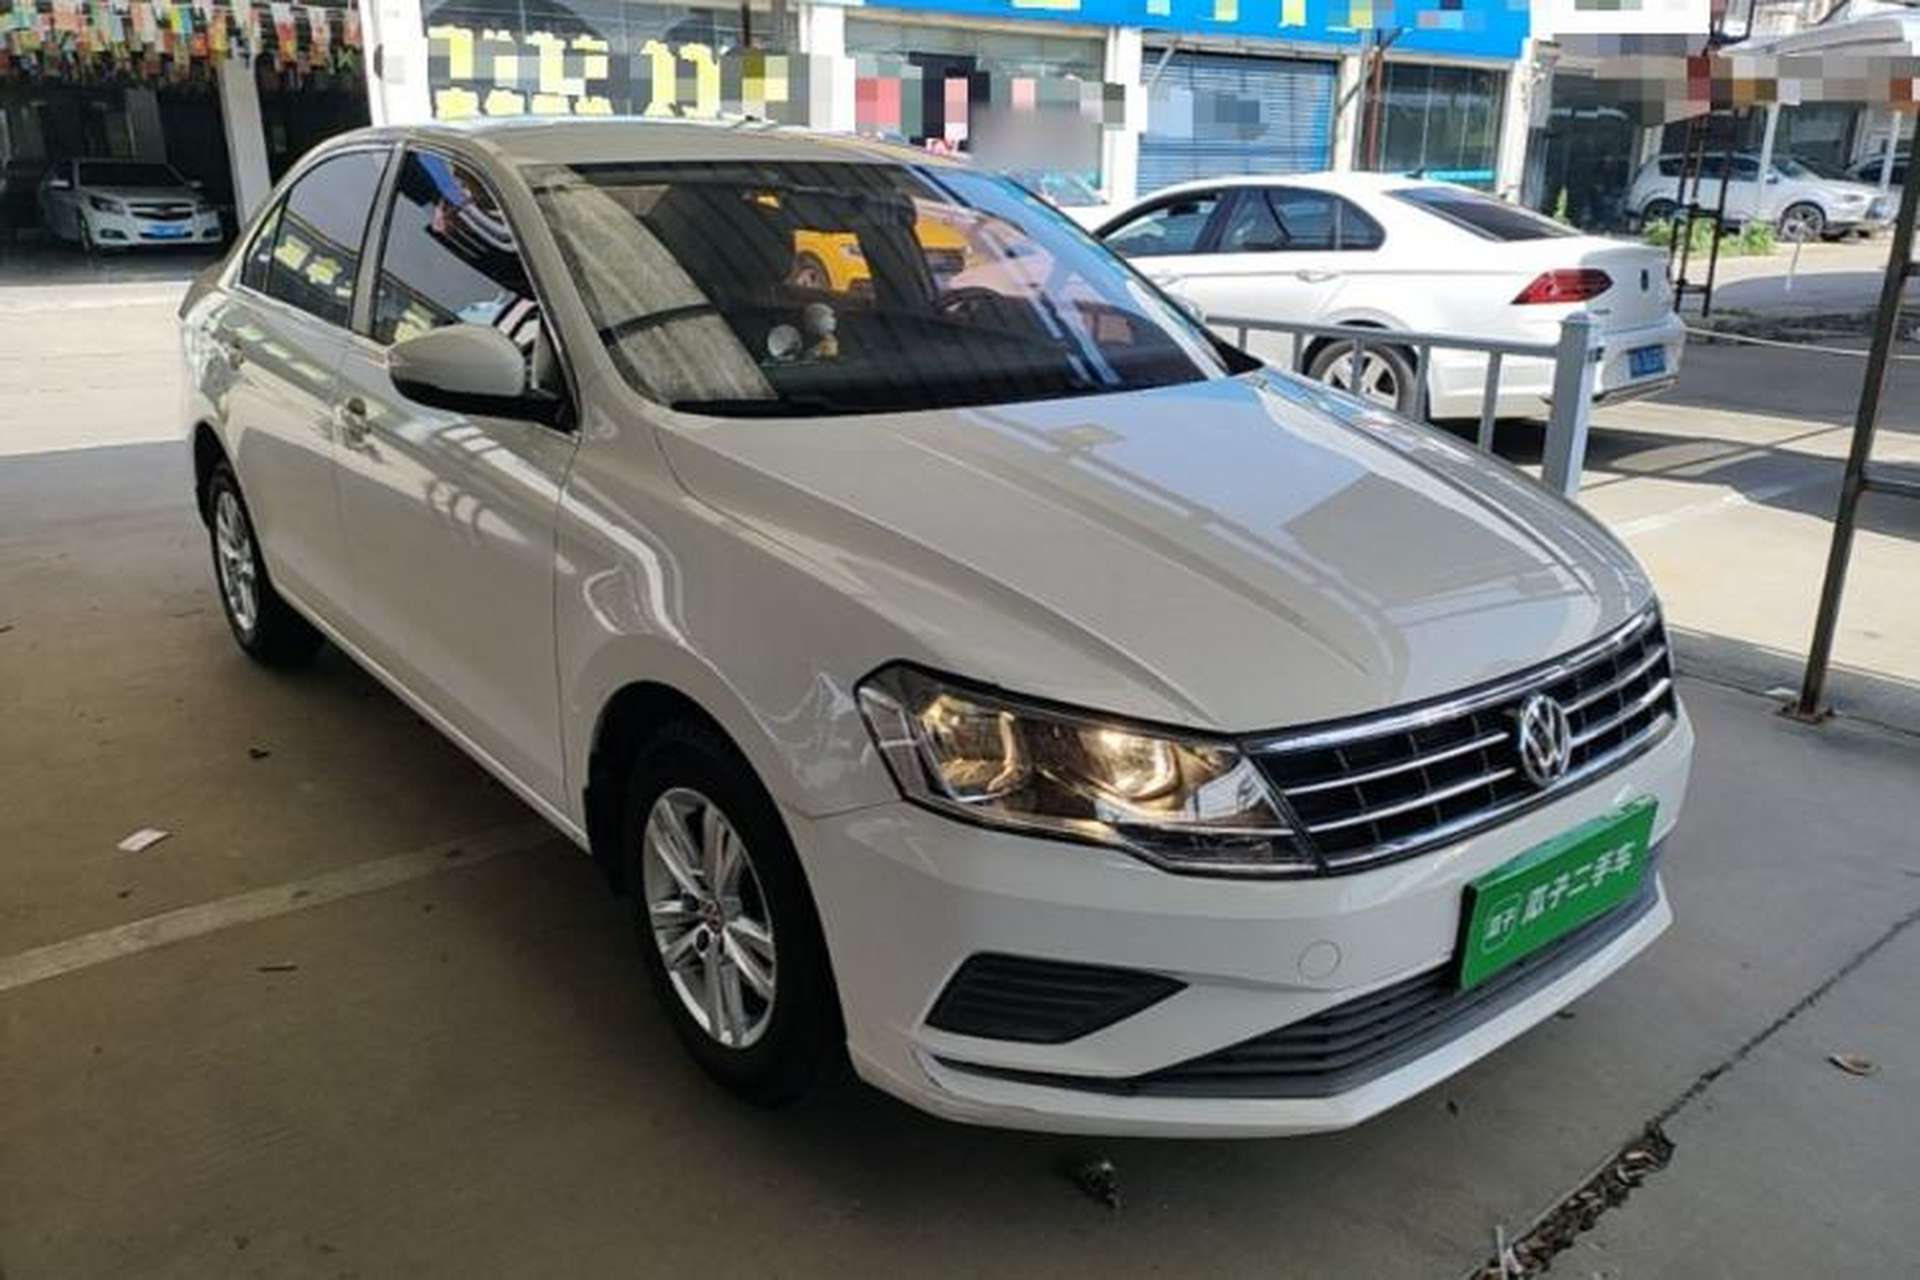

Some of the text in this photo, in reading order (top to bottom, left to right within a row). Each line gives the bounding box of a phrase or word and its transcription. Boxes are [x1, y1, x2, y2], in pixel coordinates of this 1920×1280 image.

[1520, 842, 1636, 925] 瓜子二手车
